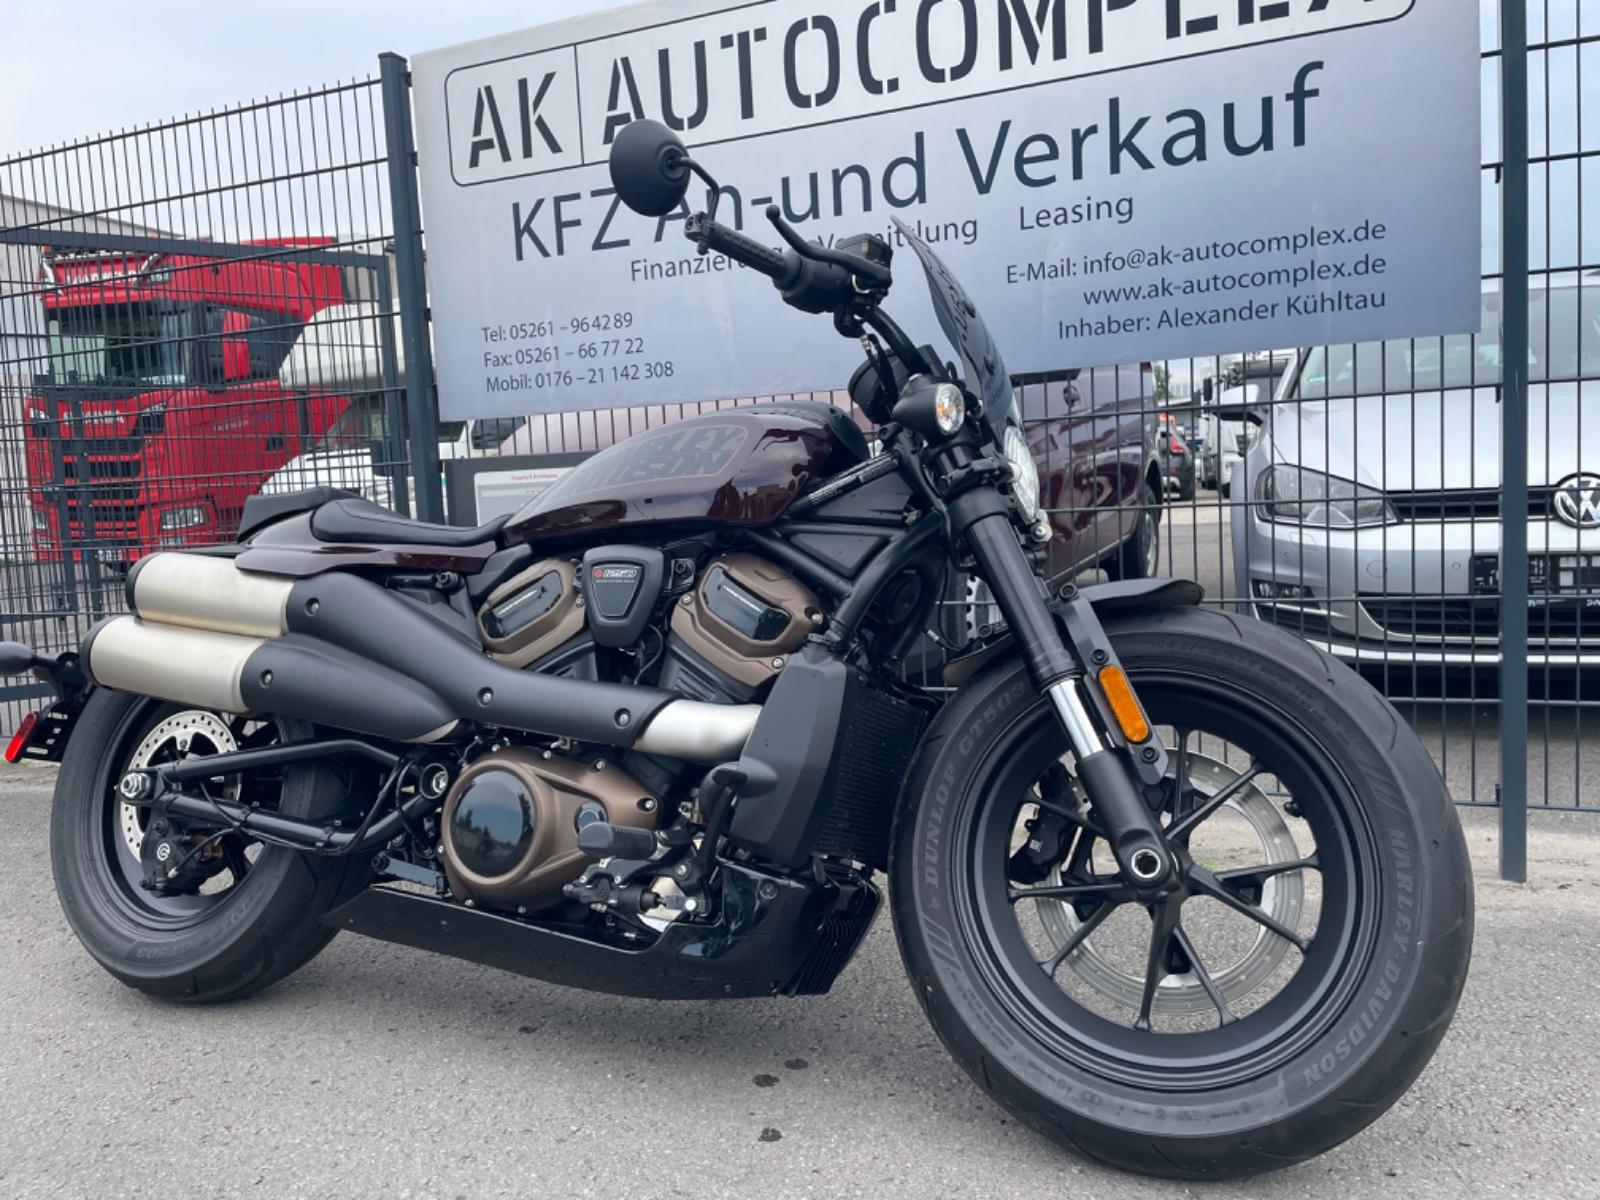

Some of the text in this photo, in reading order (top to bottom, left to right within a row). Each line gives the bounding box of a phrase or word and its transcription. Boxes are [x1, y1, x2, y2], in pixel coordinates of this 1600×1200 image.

[468, 0, 1377, 168] AK AUTOCOM
[512, 187, 631, 262] KFZ
[955, 60, 1325, 196] Verkauf
[631, 246, 783, 283] Finanzier
[1019, 196, 1135, 231] Leasing
[1006, 219, 1387, 284] E-Mail: info@ak-autocomplex.de
[1083, 254, 1387, 306] www.ak-autocomplex.de
[481, 326, 507, 343] Tel:
[509, 321, 554, 341] 05261
[1058, 290, 1386, 340] Inhaber: Alexander Kühltau
[483, 351, 513, 368] Fax:
[515, 345, 560, 366] 05261
[578, 342, 598, 359] 66
[601, 339, 620, 357] 77
[624, 337, 645, 355] 22
[486, 373, 533, 393] Mobil:
[535, 369, 573, 389] 0176
[587, 366, 605, 384] 21
[612, 363, 640, 382] 142
[644, 360, 675, 380] 308
[61, 410, 126, 425] SANIA
[924, 762, 956, 889] DUNLOP
